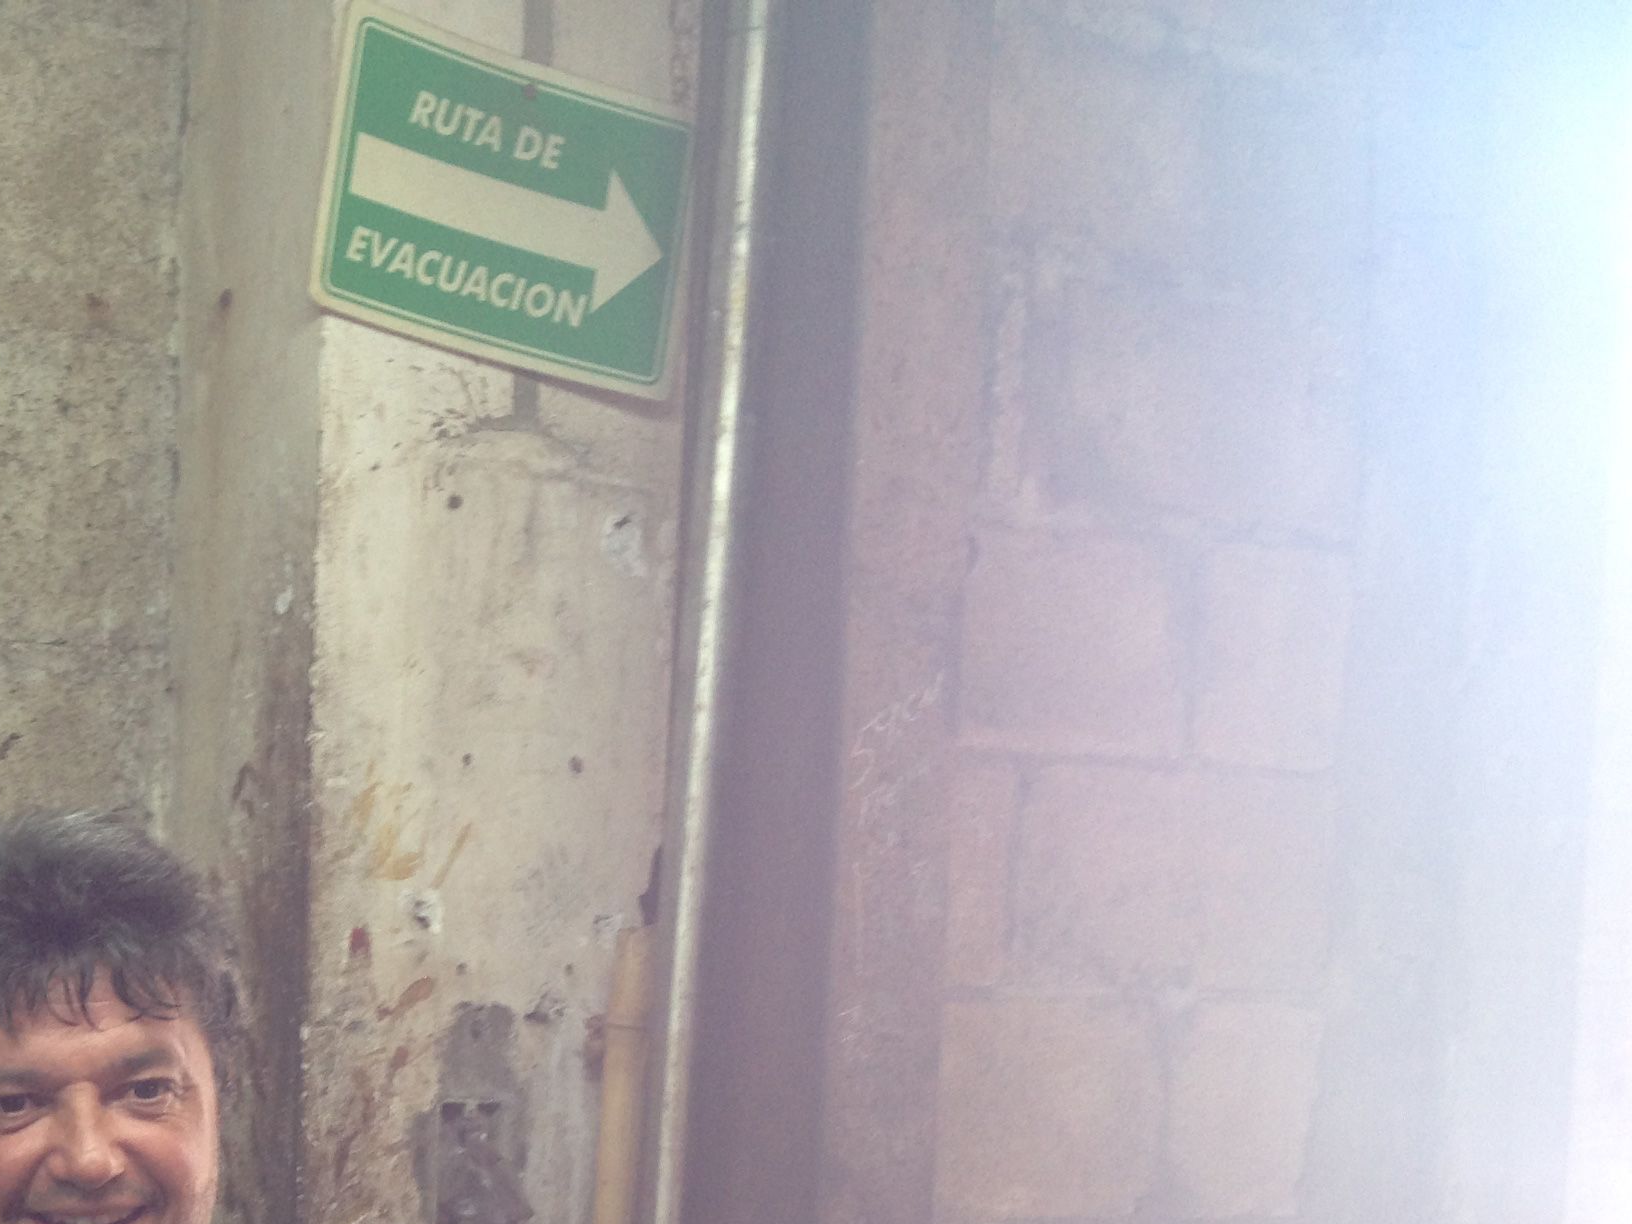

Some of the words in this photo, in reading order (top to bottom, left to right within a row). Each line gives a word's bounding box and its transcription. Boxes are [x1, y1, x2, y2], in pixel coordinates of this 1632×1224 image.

[409, 91, 503, 152] RUTA
[514, 126, 565, 169] DE
[346, 226, 588, 327] EVACUACION
